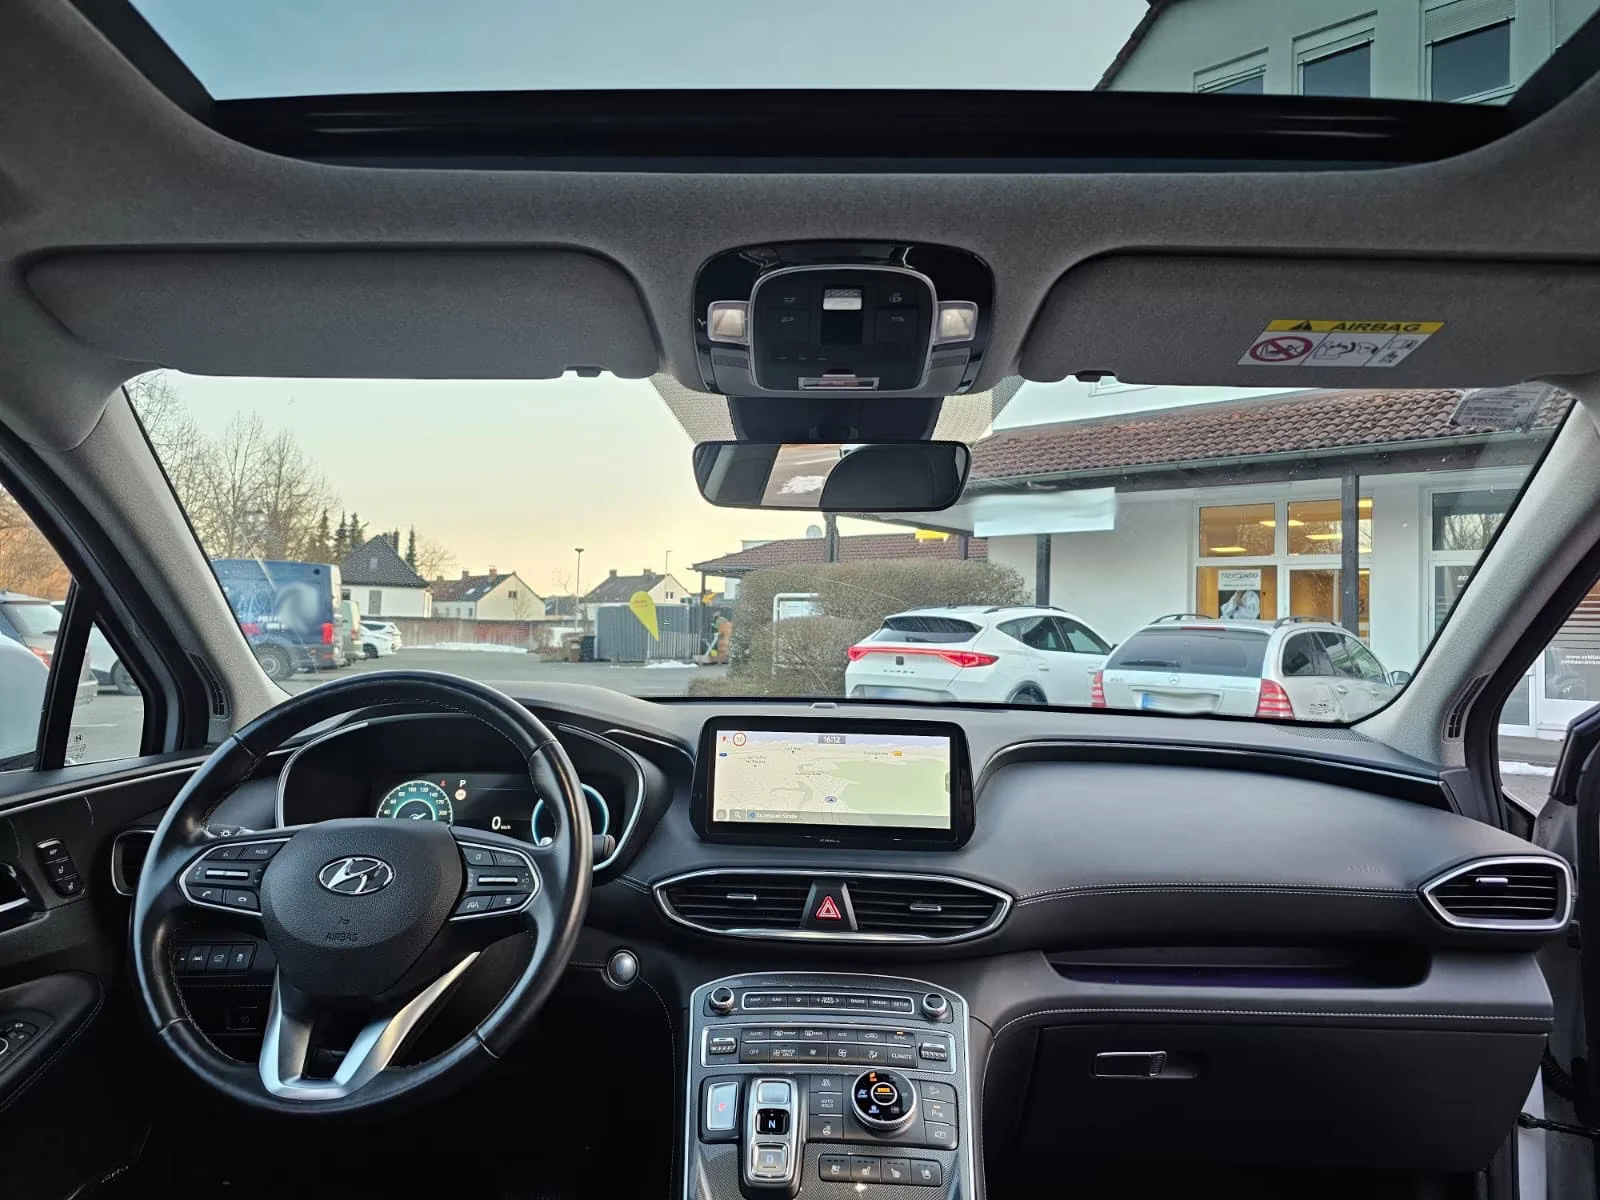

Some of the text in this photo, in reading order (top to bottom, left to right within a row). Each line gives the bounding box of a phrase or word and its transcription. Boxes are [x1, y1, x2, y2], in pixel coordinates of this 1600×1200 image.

[1330, 322, 1423, 332] AIRBAG
[459, 779, 466, 787] P
[491, 816, 501, 830] 0
[326, 932, 359, 941] AIRBAG
[768, 1120, 776, 1129] N
